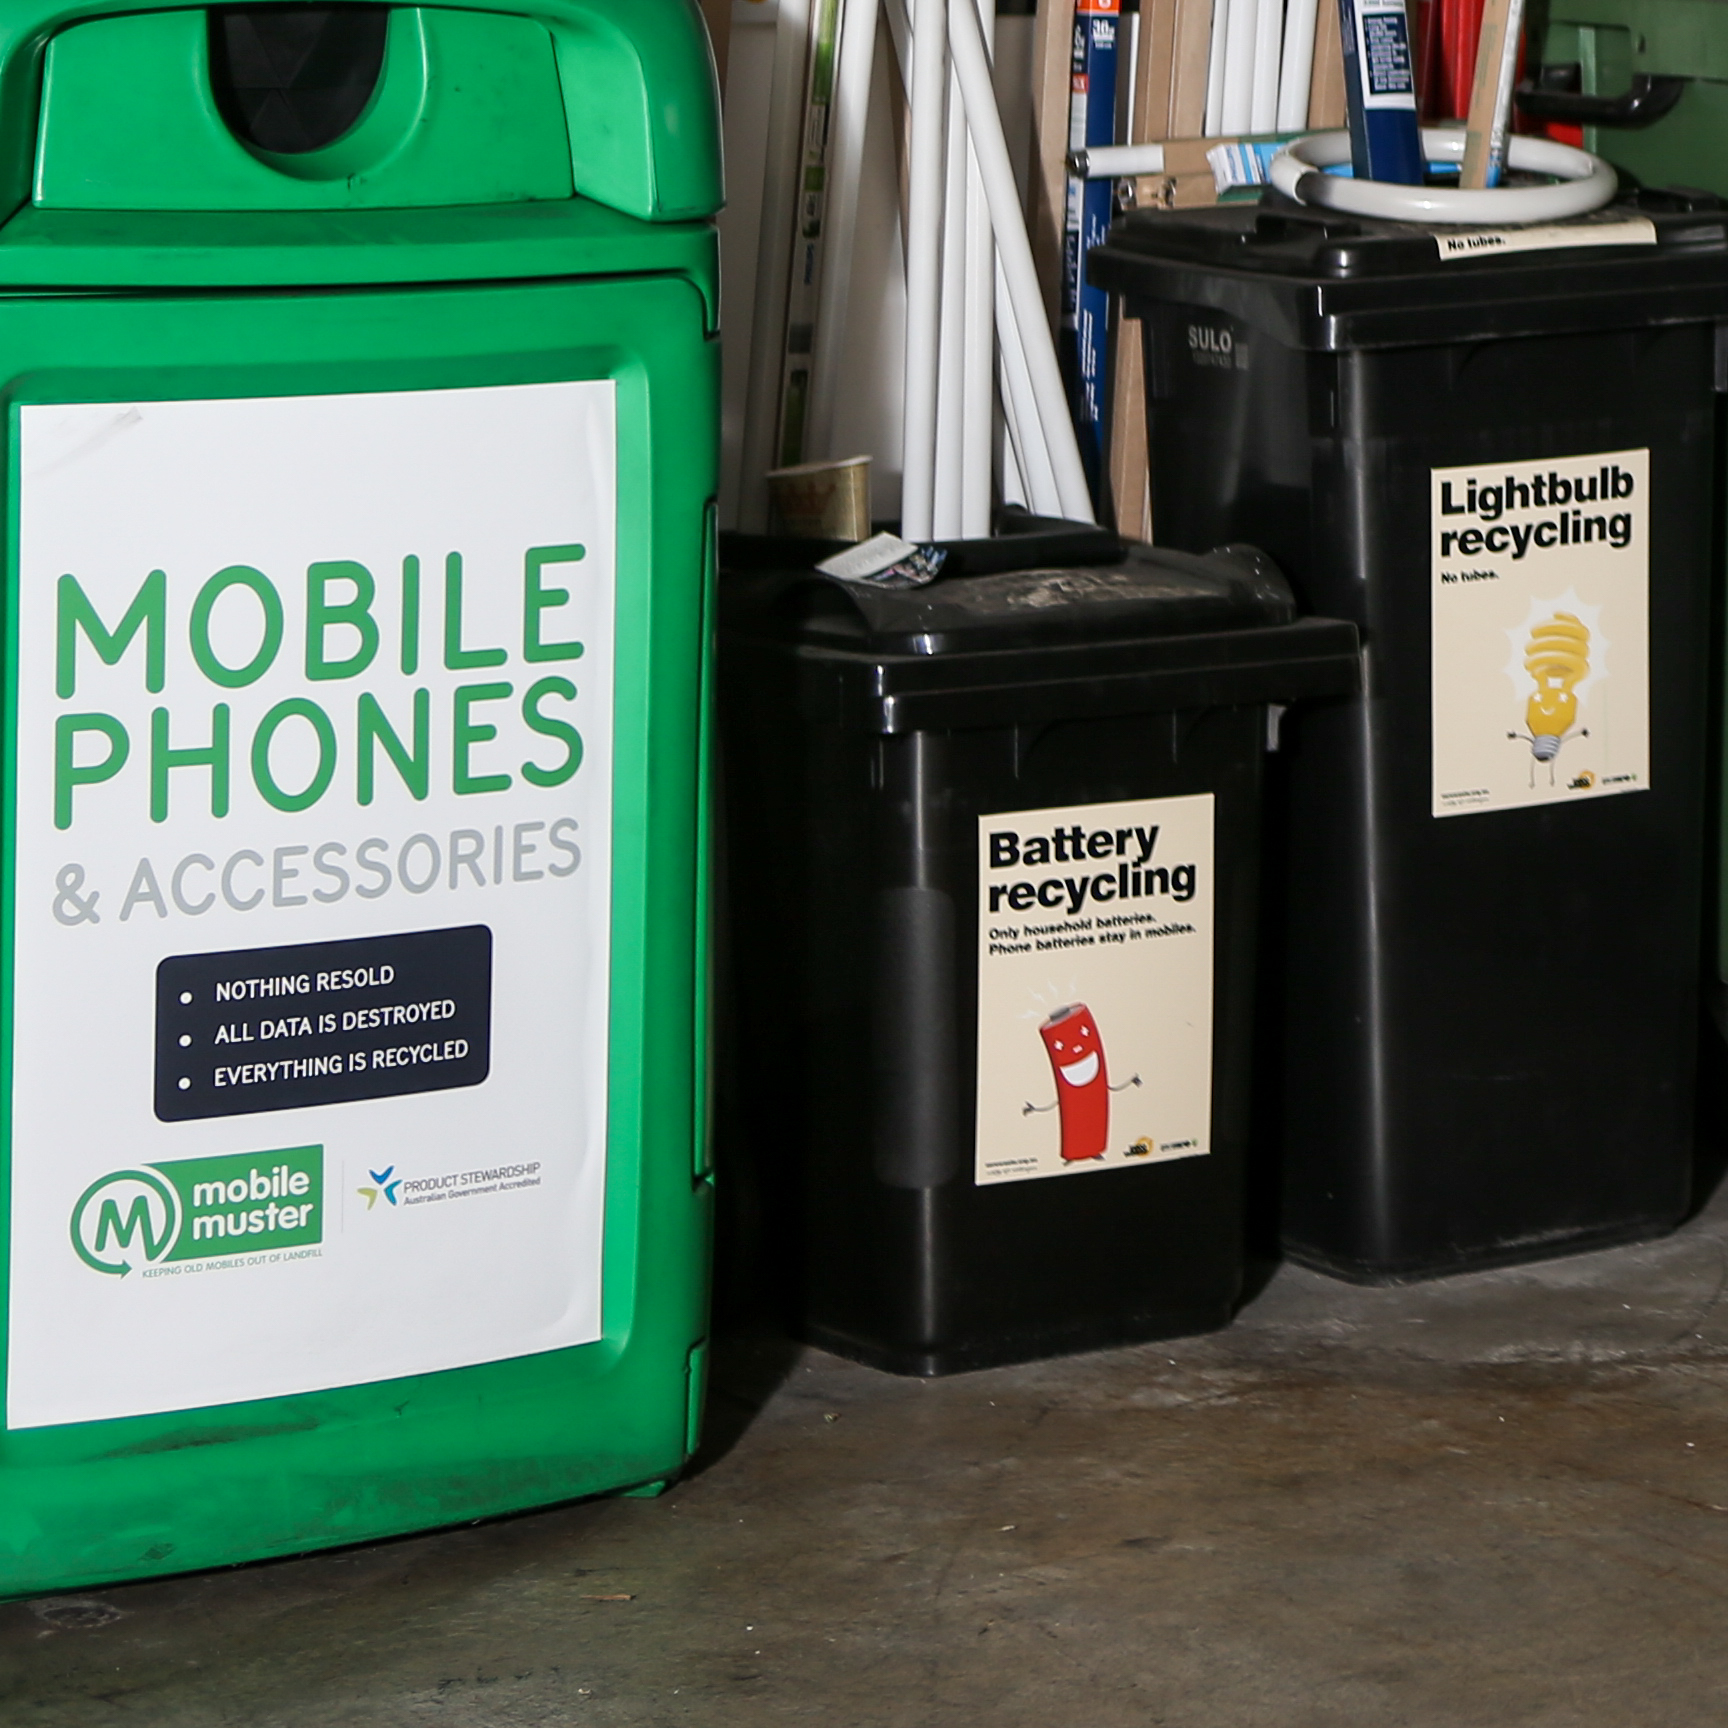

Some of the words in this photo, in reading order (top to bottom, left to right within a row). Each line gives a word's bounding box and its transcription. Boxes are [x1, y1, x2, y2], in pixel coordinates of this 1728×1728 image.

[1447, 239, 1464, 251] No
[1467, 236, 1506, 249] tubes.
[1188, 324, 1232, 353] SULO
[1441, 465, 1634, 521] Lightbulb
[1441, 510, 1631, 560] recycling
[1441, 572, 1458, 585] No
[1461, 569, 1499, 582] tubes.
[56, 542, 586, 700] MOBILE
[54, 675, 584, 832] PHONES
[989, 825, 1159, 868] Battery
[52, 862, 101, 927] &
[118, 817, 583, 923] ACCESSORIES
[989, 862, 1196, 915] recycling
[989, 926, 1019, 941] Only
[1024, 918, 1093, 937] household
[1096, 911, 1156, 928] batteries.
[989, 940, 1032, 956] Phone
[1036, 933, 1095, 951] batteries
[1099, 930, 1126, 944] stay
[1129, 929, 1142, 941] in
[1145, 923, 1196, 938] mobiles.
[215, 974, 311, 1003] NOTHING
[316, 964, 395, 992] RESOLD
[214, 1022, 255, 1045] ALL
[260, 1016, 313, 1041] DATA
[318, 1014, 337, 1034] IS
[342, 998, 456, 1032] DESTROYED
[213, 1054, 343, 1087] EVERYTHING
[349, 1052, 367, 1072] IS
[372, 1038, 469, 1070] RECYCLED
[192, 1164, 310, 1208] mobile
[403, 1173, 459, 1194] PRODUCT
[460, 1161, 541, 1185] STEWARDSHIP
[403, 1191, 447, 1207] Australian
[448, 1184, 497, 1199] Government
[498, 1177, 541, 1191] Accredited
[192, 1202, 314, 1241] muster
[142, 1264, 182, 1279] KEEPING
[184, 1262, 203, 1274] OLD
[206, 1257, 245, 1272] MOBILES
[248, 1255, 267, 1266] OUT
[269, 1253, 282, 1263] OF
[283, 1248, 323, 1262] LANDFILL
